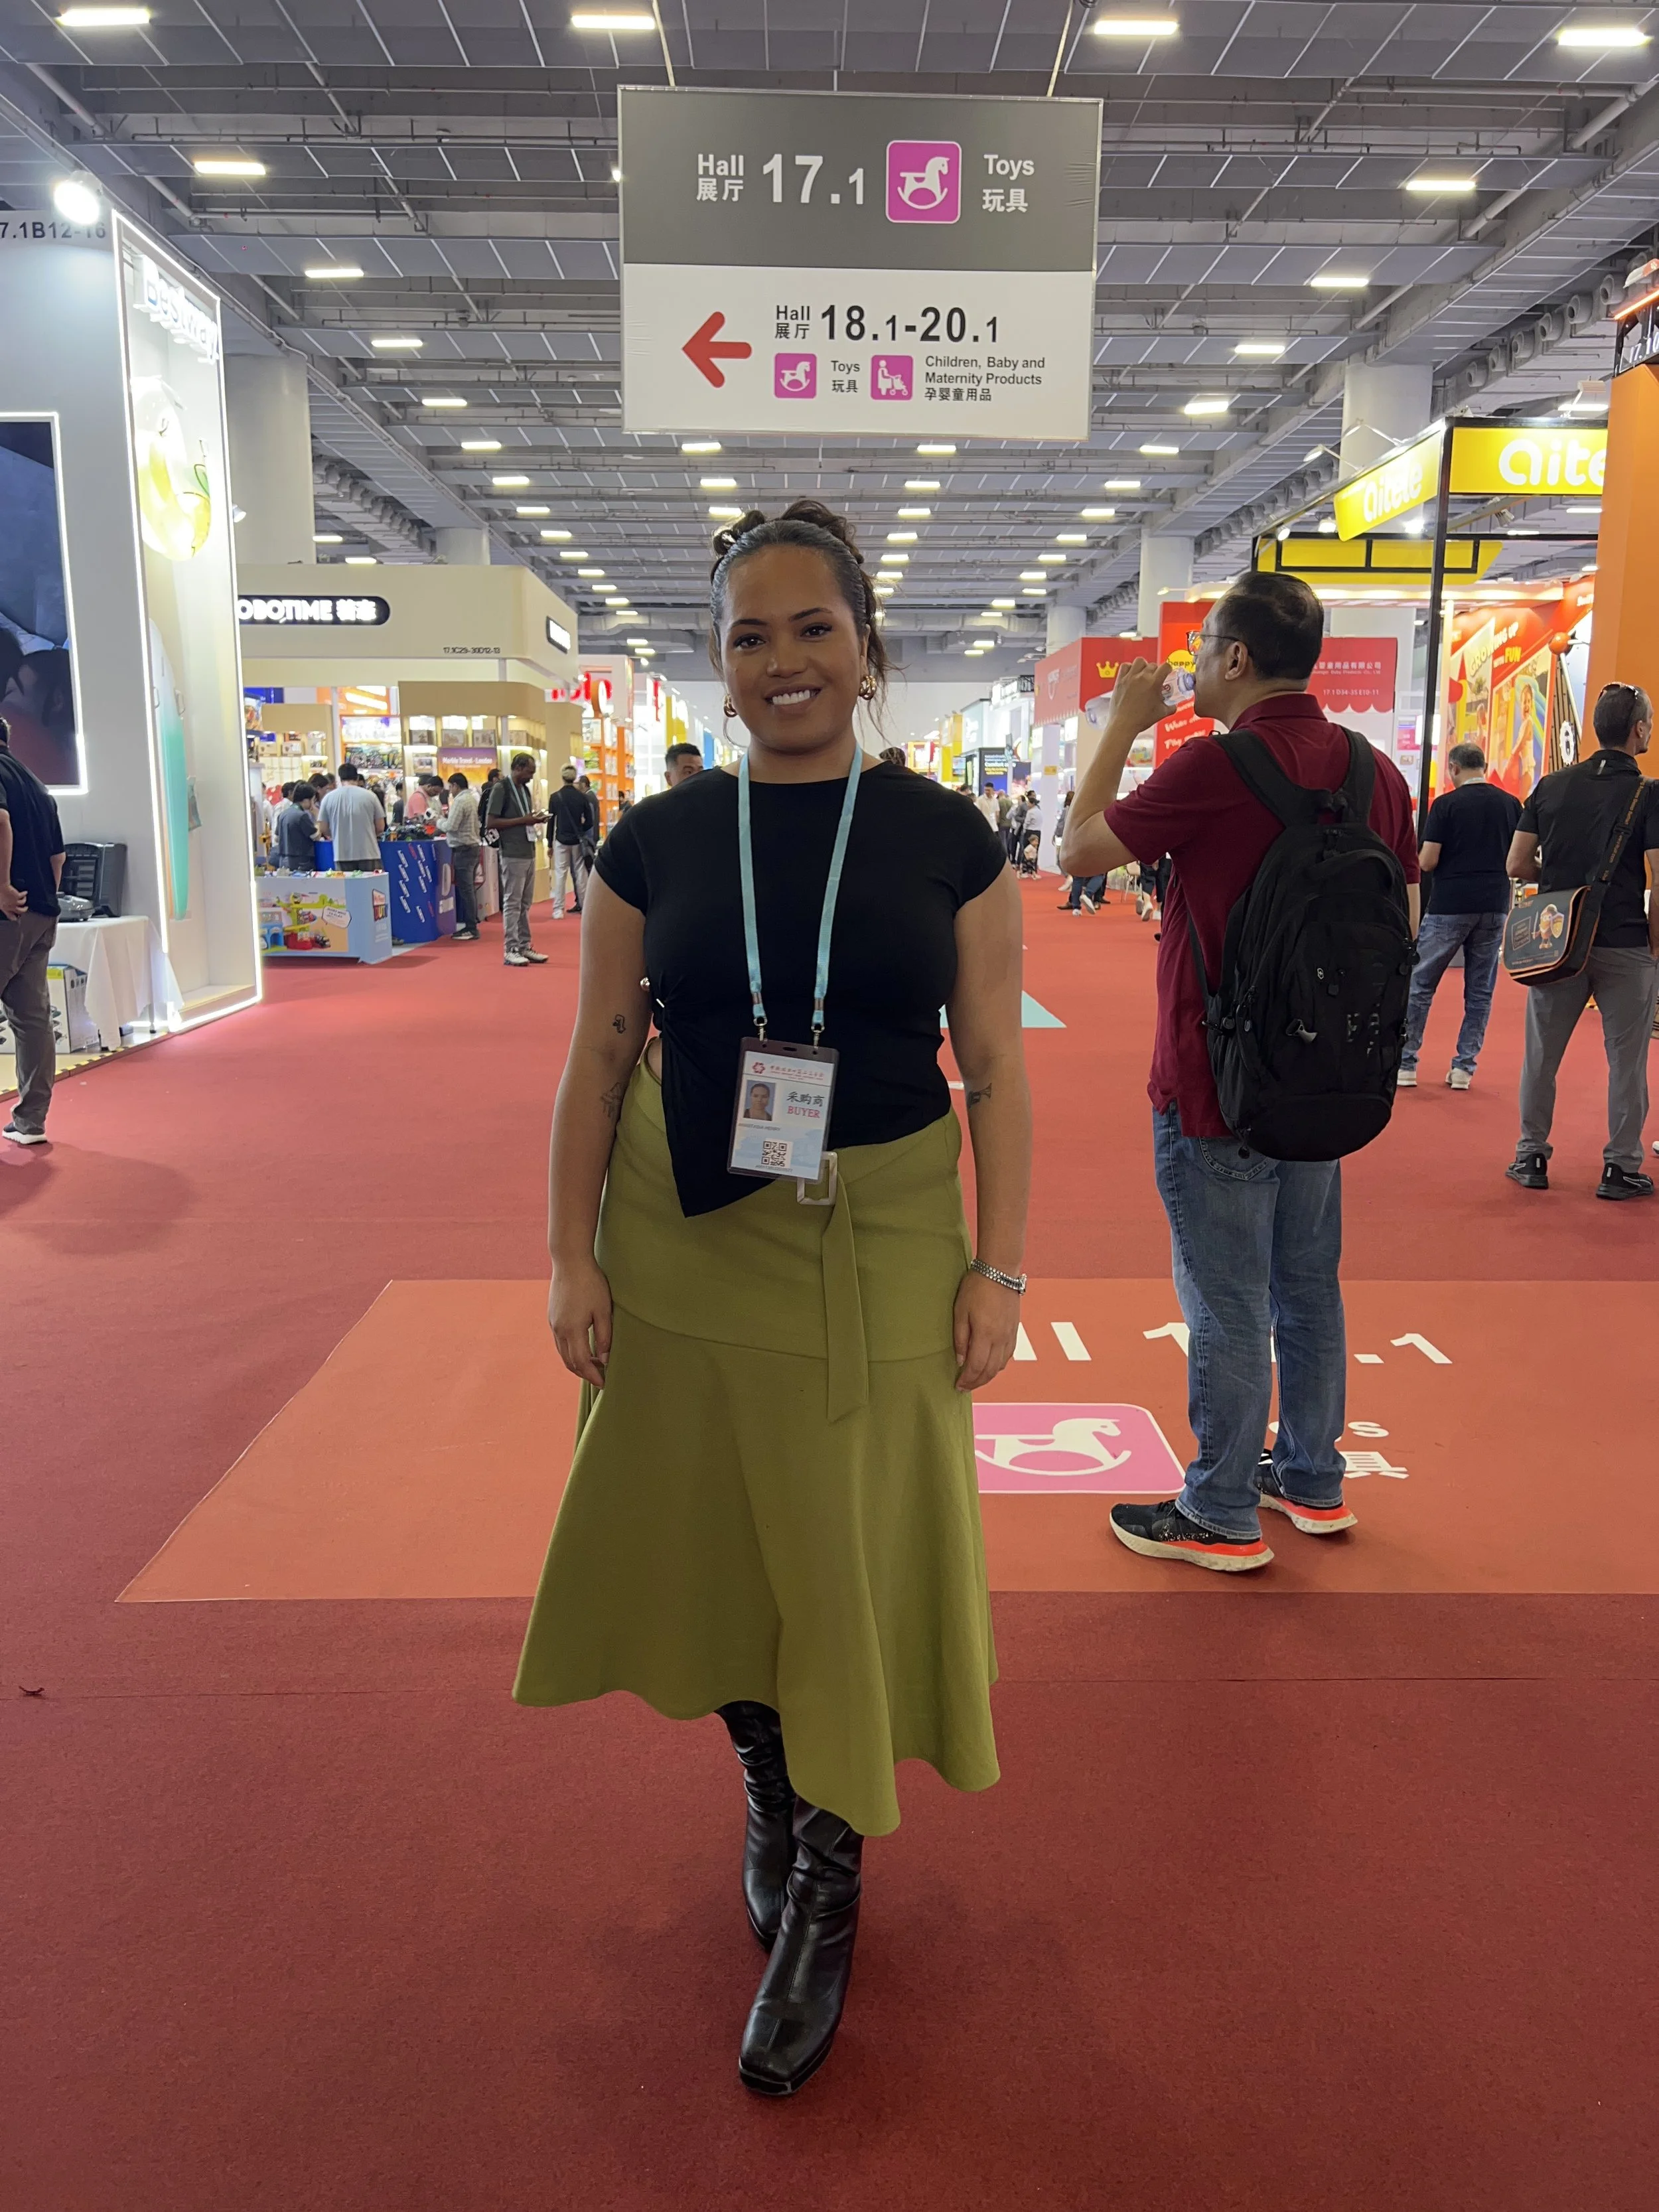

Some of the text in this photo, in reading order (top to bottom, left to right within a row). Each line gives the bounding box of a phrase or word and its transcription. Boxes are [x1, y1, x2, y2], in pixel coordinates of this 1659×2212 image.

[697, 153, 1035, 204] Hall 17.1 Toys
[696, 179, 744, 202] 展厅
[982, 189, 1028, 213] 玩具
[774, 323, 810, 340] 展厅
[775, 305, 998, 342] Hall 18.1-20.1
[831, 360, 861, 374] Toys
[925, 356, 1046, 371] Children, Baby and
[831, 379, 859, 394] 玩具
[924, 372, 1043, 387] Maternity Products
[924, 388, 992, 402] 孕婴童用品
[1470, 621, 1520, 678] GROWING UP
[1504, 646, 1522, 663] FUN
[786, 1091, 825, 1107] 采购商
[787, 1105, 821, 1119] BUYER
